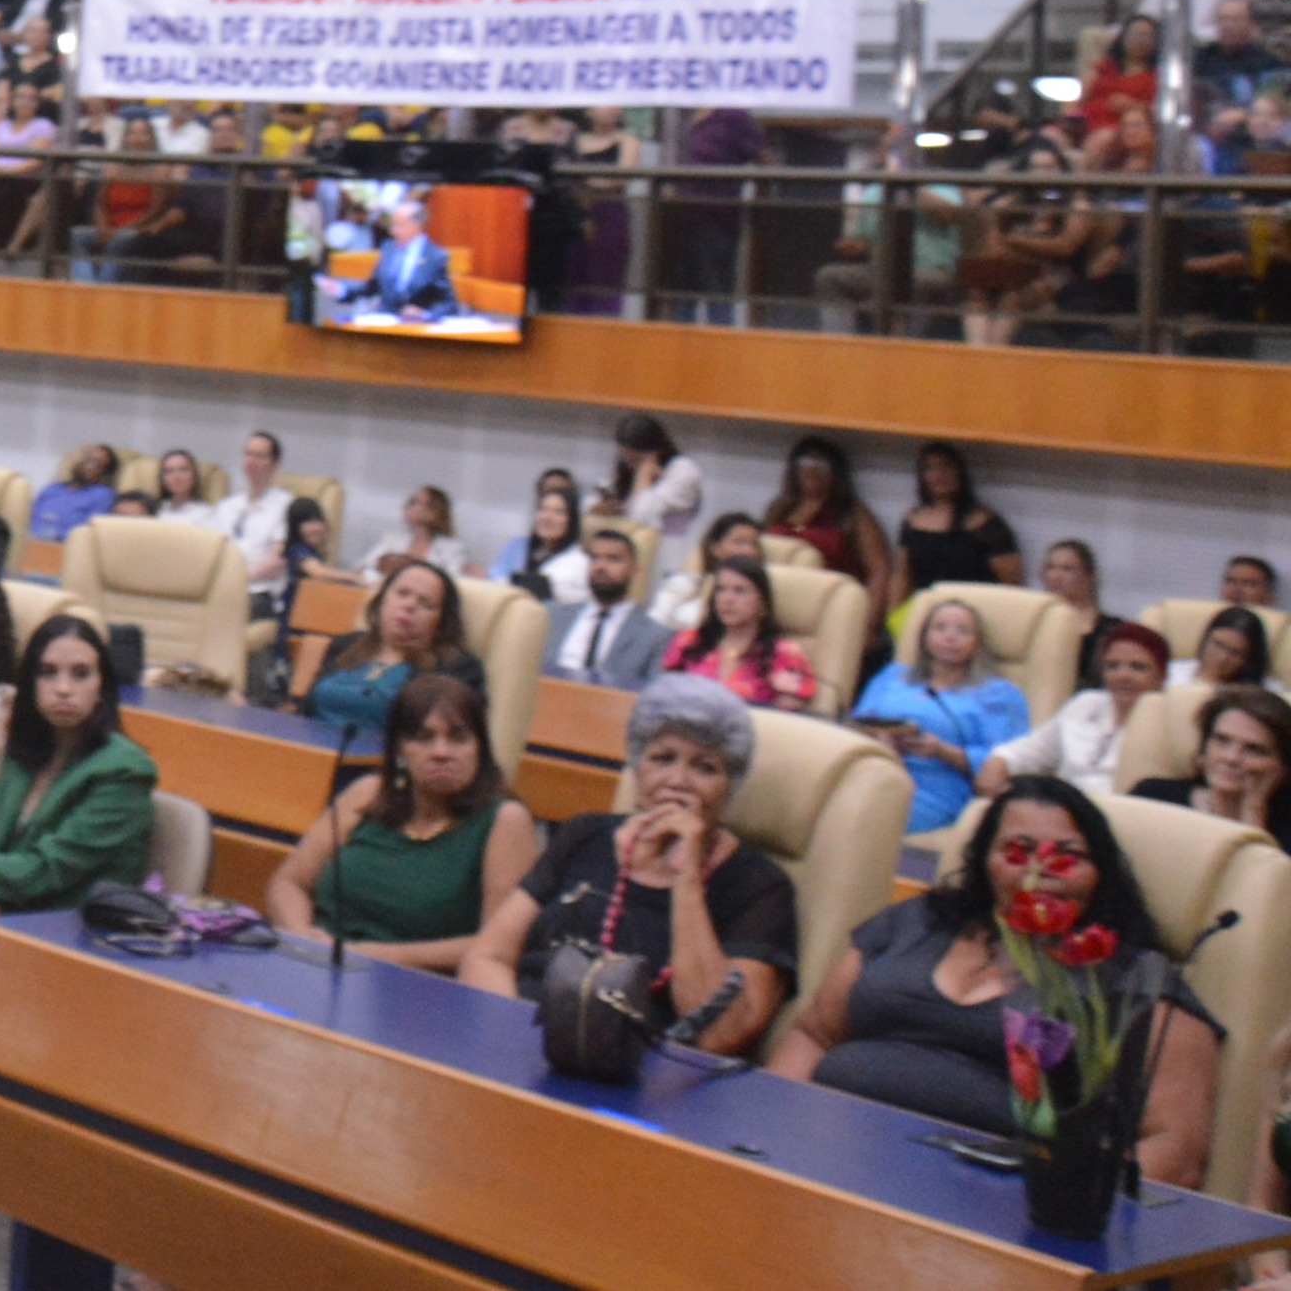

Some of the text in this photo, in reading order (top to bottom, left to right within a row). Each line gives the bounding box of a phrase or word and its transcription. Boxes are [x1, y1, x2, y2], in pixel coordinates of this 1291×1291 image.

[220, 16, 250, 45] DE
[390, 17, 473, 46] JUSTA
[482, 12, 658, 46] HOMENAGEM
[667, 12, 688, 42] A
[699, 8, 797, 43] TODOS
[498, 61, 565, 92] AQUI
[573, 58, 828, 92] REPRESENTANDO
